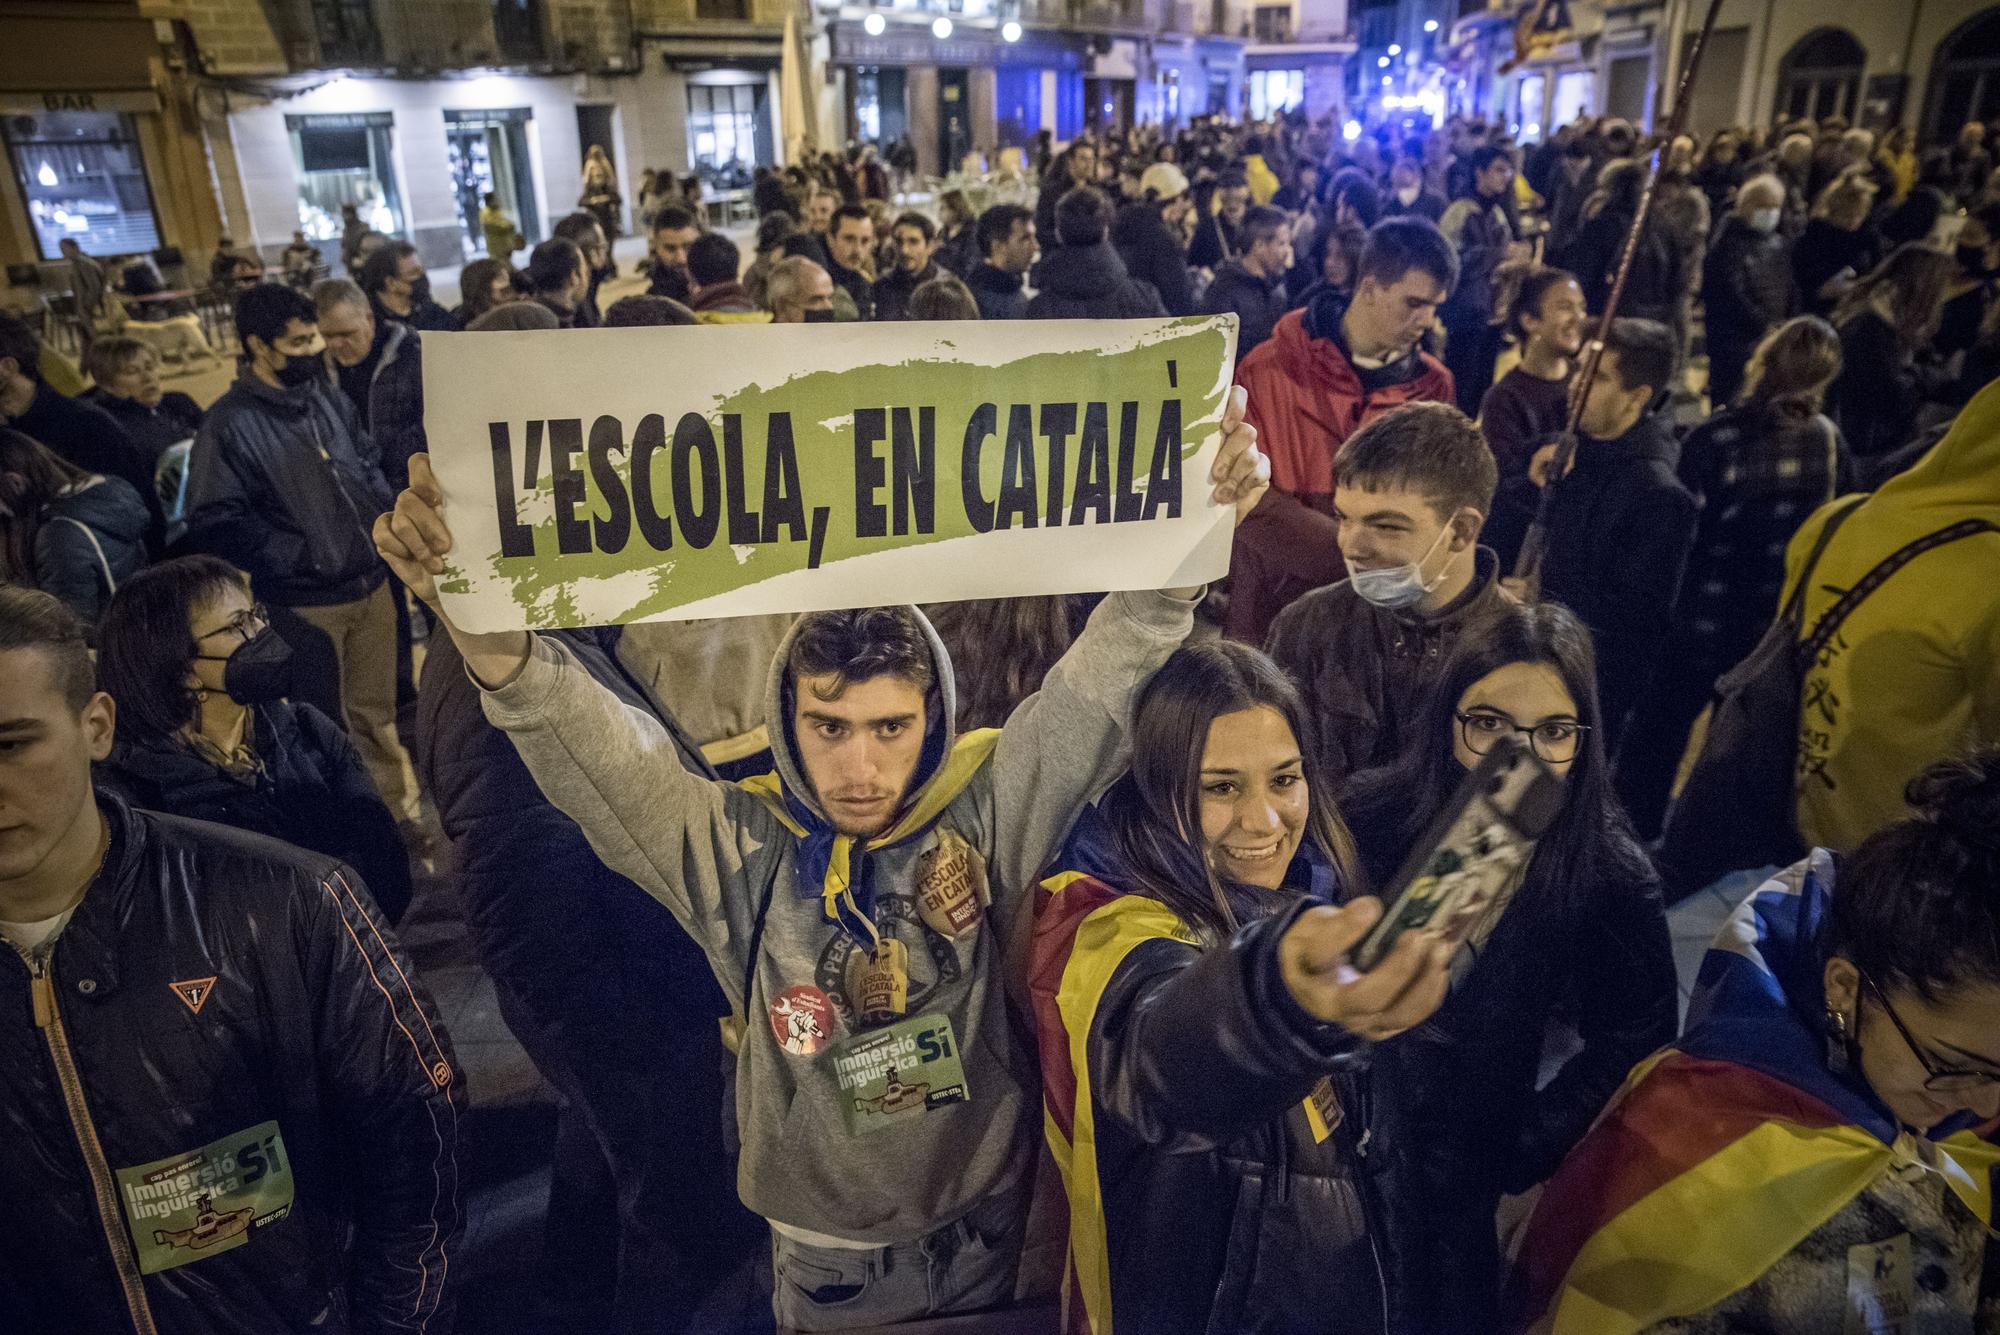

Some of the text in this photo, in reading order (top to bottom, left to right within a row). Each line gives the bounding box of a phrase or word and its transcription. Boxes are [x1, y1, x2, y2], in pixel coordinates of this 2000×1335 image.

[42, 95, 97, 112] BAR
[489, 359, 1183, 569] L'ESCOLA, EN CATALÀ
[925, 891, 945, 911] EN
[833, 1034, 916, 1074] Immersió
[917, 1026, 952, 1064] Sí
[126, 1153, 236, 1203] Immersió
[150, 1155, 202, 1183] cap pas enrere!
[237, 1134, 283, 1184] Sí
